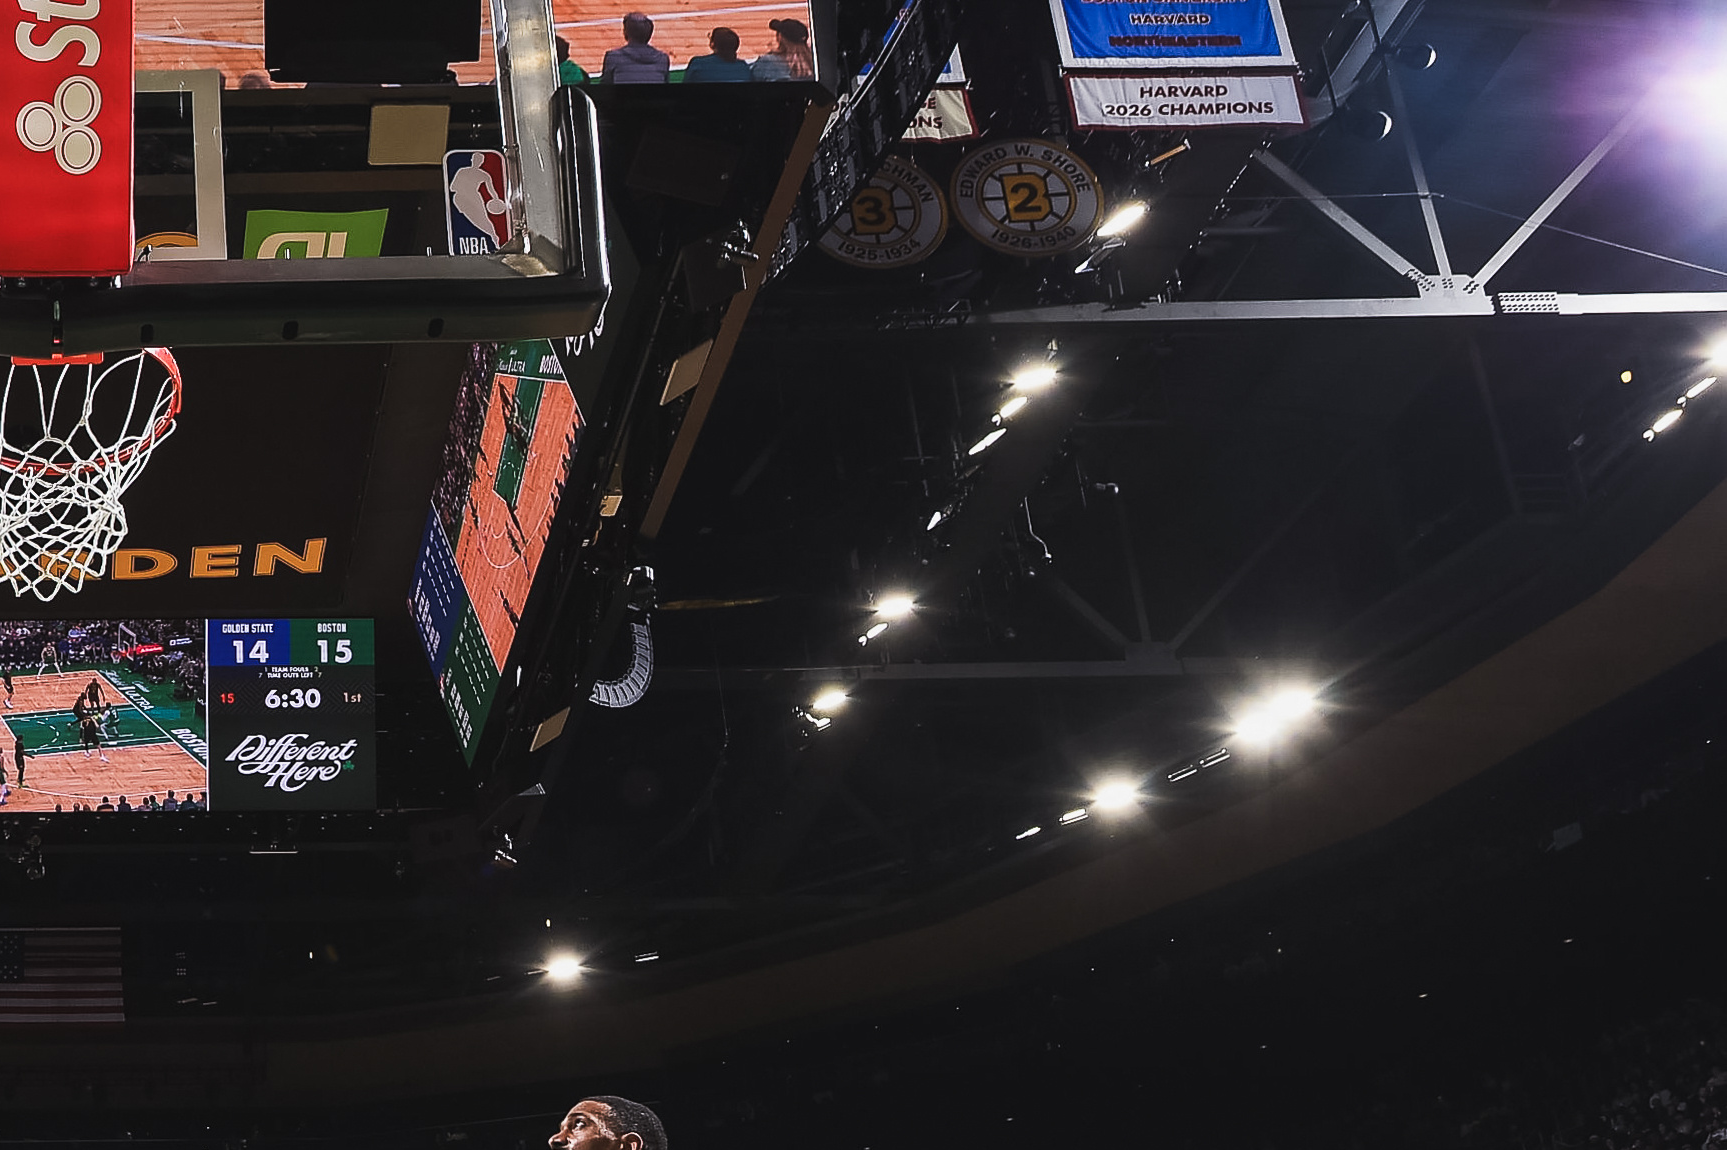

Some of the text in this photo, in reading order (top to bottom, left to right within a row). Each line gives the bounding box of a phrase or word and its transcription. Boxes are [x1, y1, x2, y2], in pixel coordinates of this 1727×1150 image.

[1129, 13, 1211, 25] HARVARD
[1139, 85, 1228, 99] HARVARD
[1105, 101, 1274, 117] 2026 CHAMPIONS
[960, 147, 1007, 199] EDWARD
[1041, 150, 1091, 192] SHORE
[1011, 182, 1042, 213] 2
[856, 196, 887, 226] 3
[460, 237, 488, 254] NBA
[991, 225, 1076, 249] 1926-1940
[222, 624, 274, 633] GOLDEN STATE
[317, 623, 347, 633] BOSTON
[233, 640, 269, 664] 14
[317, 639, 353, 664] 15
[220, 688, 362, 708] 15 6:30 1st
[225, 733, 358, 774] Different
[264, 760, 342, 792] Here
